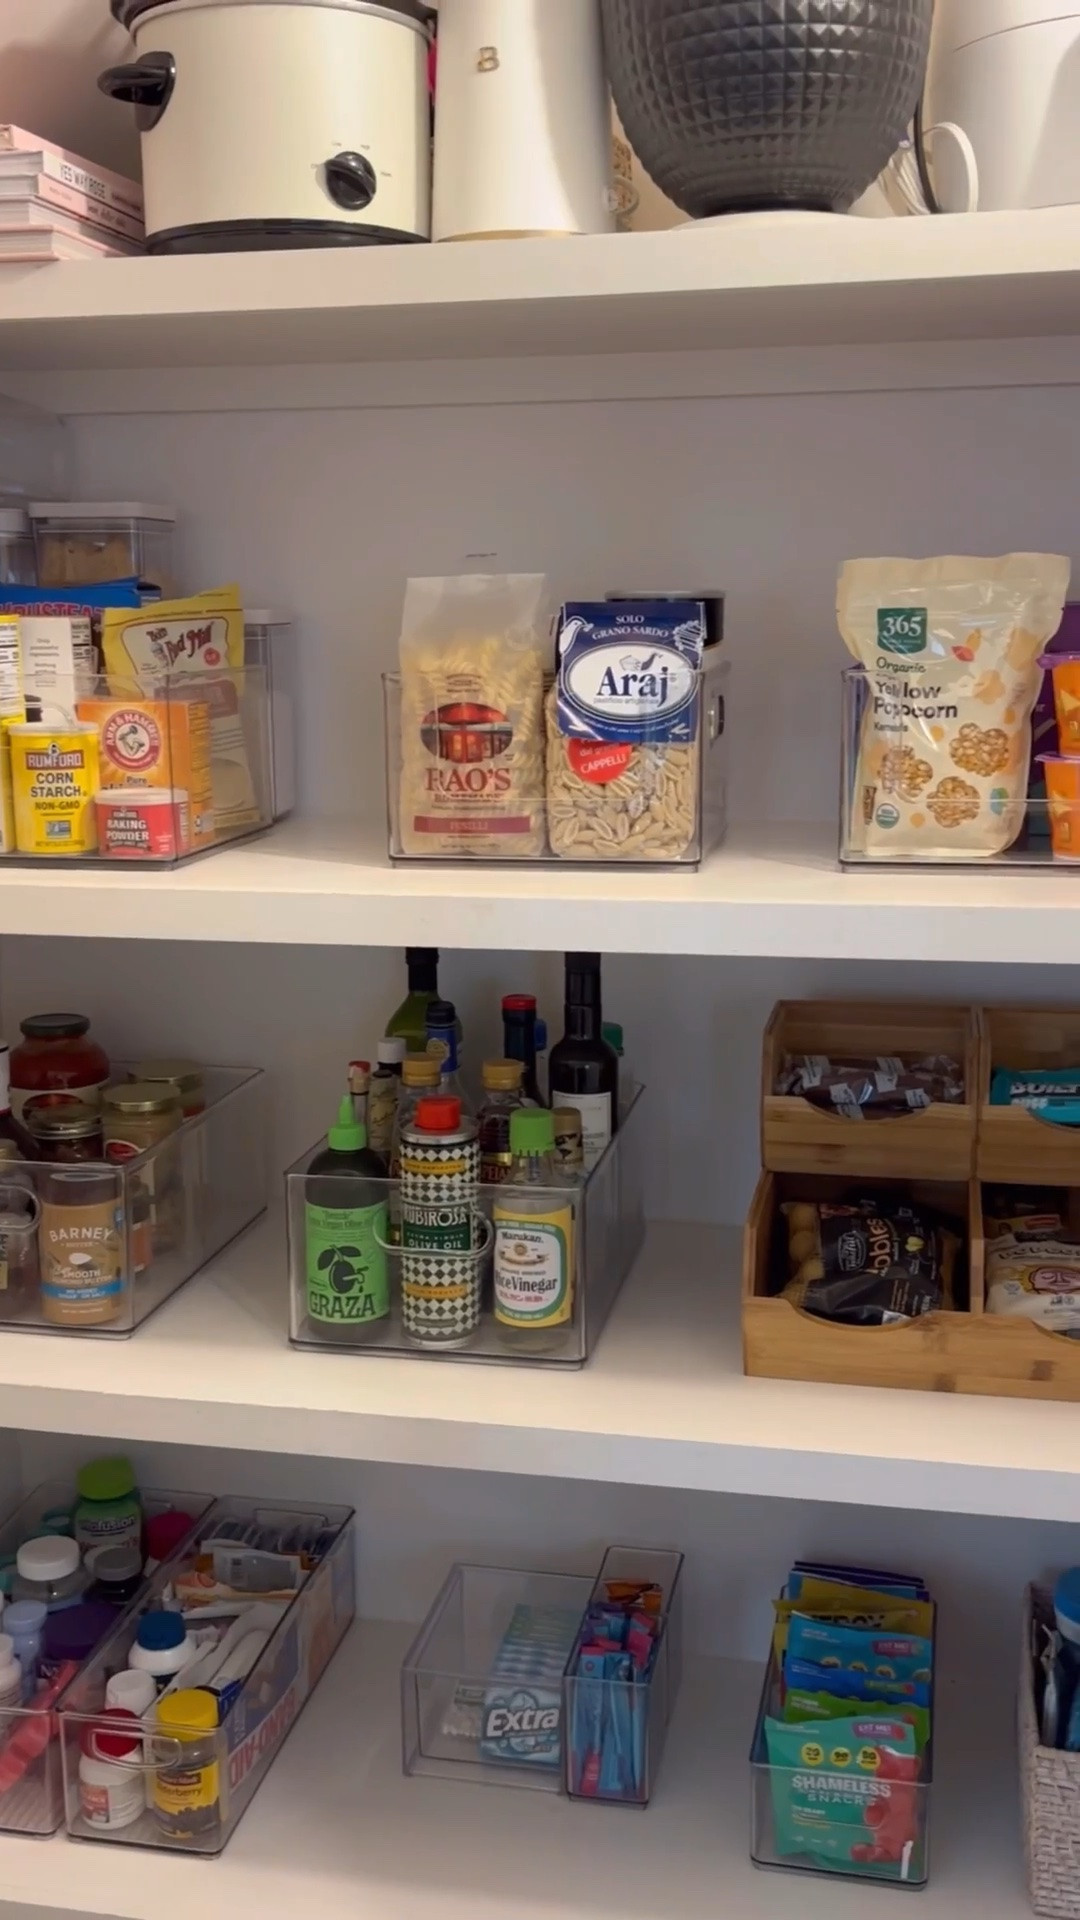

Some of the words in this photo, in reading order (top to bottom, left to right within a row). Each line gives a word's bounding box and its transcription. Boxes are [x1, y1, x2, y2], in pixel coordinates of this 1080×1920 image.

[616, 615, 645, 625] SOLO
[883, 615, 923, 637] 365
[592, 626, 630, 640] GRANO
[633, 626, 669, 638] SARDO
[876, 656, 927, 673] Organic
[597, 666, 669, 707] Araj
[875, 681, 941, 699] Yellow
[874, 696, 958, 719] Popcorn
[28, 753, 82, 768] RUMFORD
[580, 755, 627, 774] CAPPELLI
[36, 772, 74, 785] CORN
[425, 767, 512, 792] RAO'S
[30, 786, 81, 798] STARCH
[35, 801, 80, 811] NON-GMO
[106, 819, 148, 830] BAKING
[106, 830, 150, 841] POWDER
[49, 1227, 114, 1242] BARNEY
[408, 1239, 438, 1250] OLIVE
[443, 1240, 463, 1250] OIL
[511, 1275, 558, 1294] Vinegar
[309, 1291, 377, 1319] GRAZA
[486, 1707, 560, 1737] Extra
[792, 1775, 892, 1798] SHAMELESS
